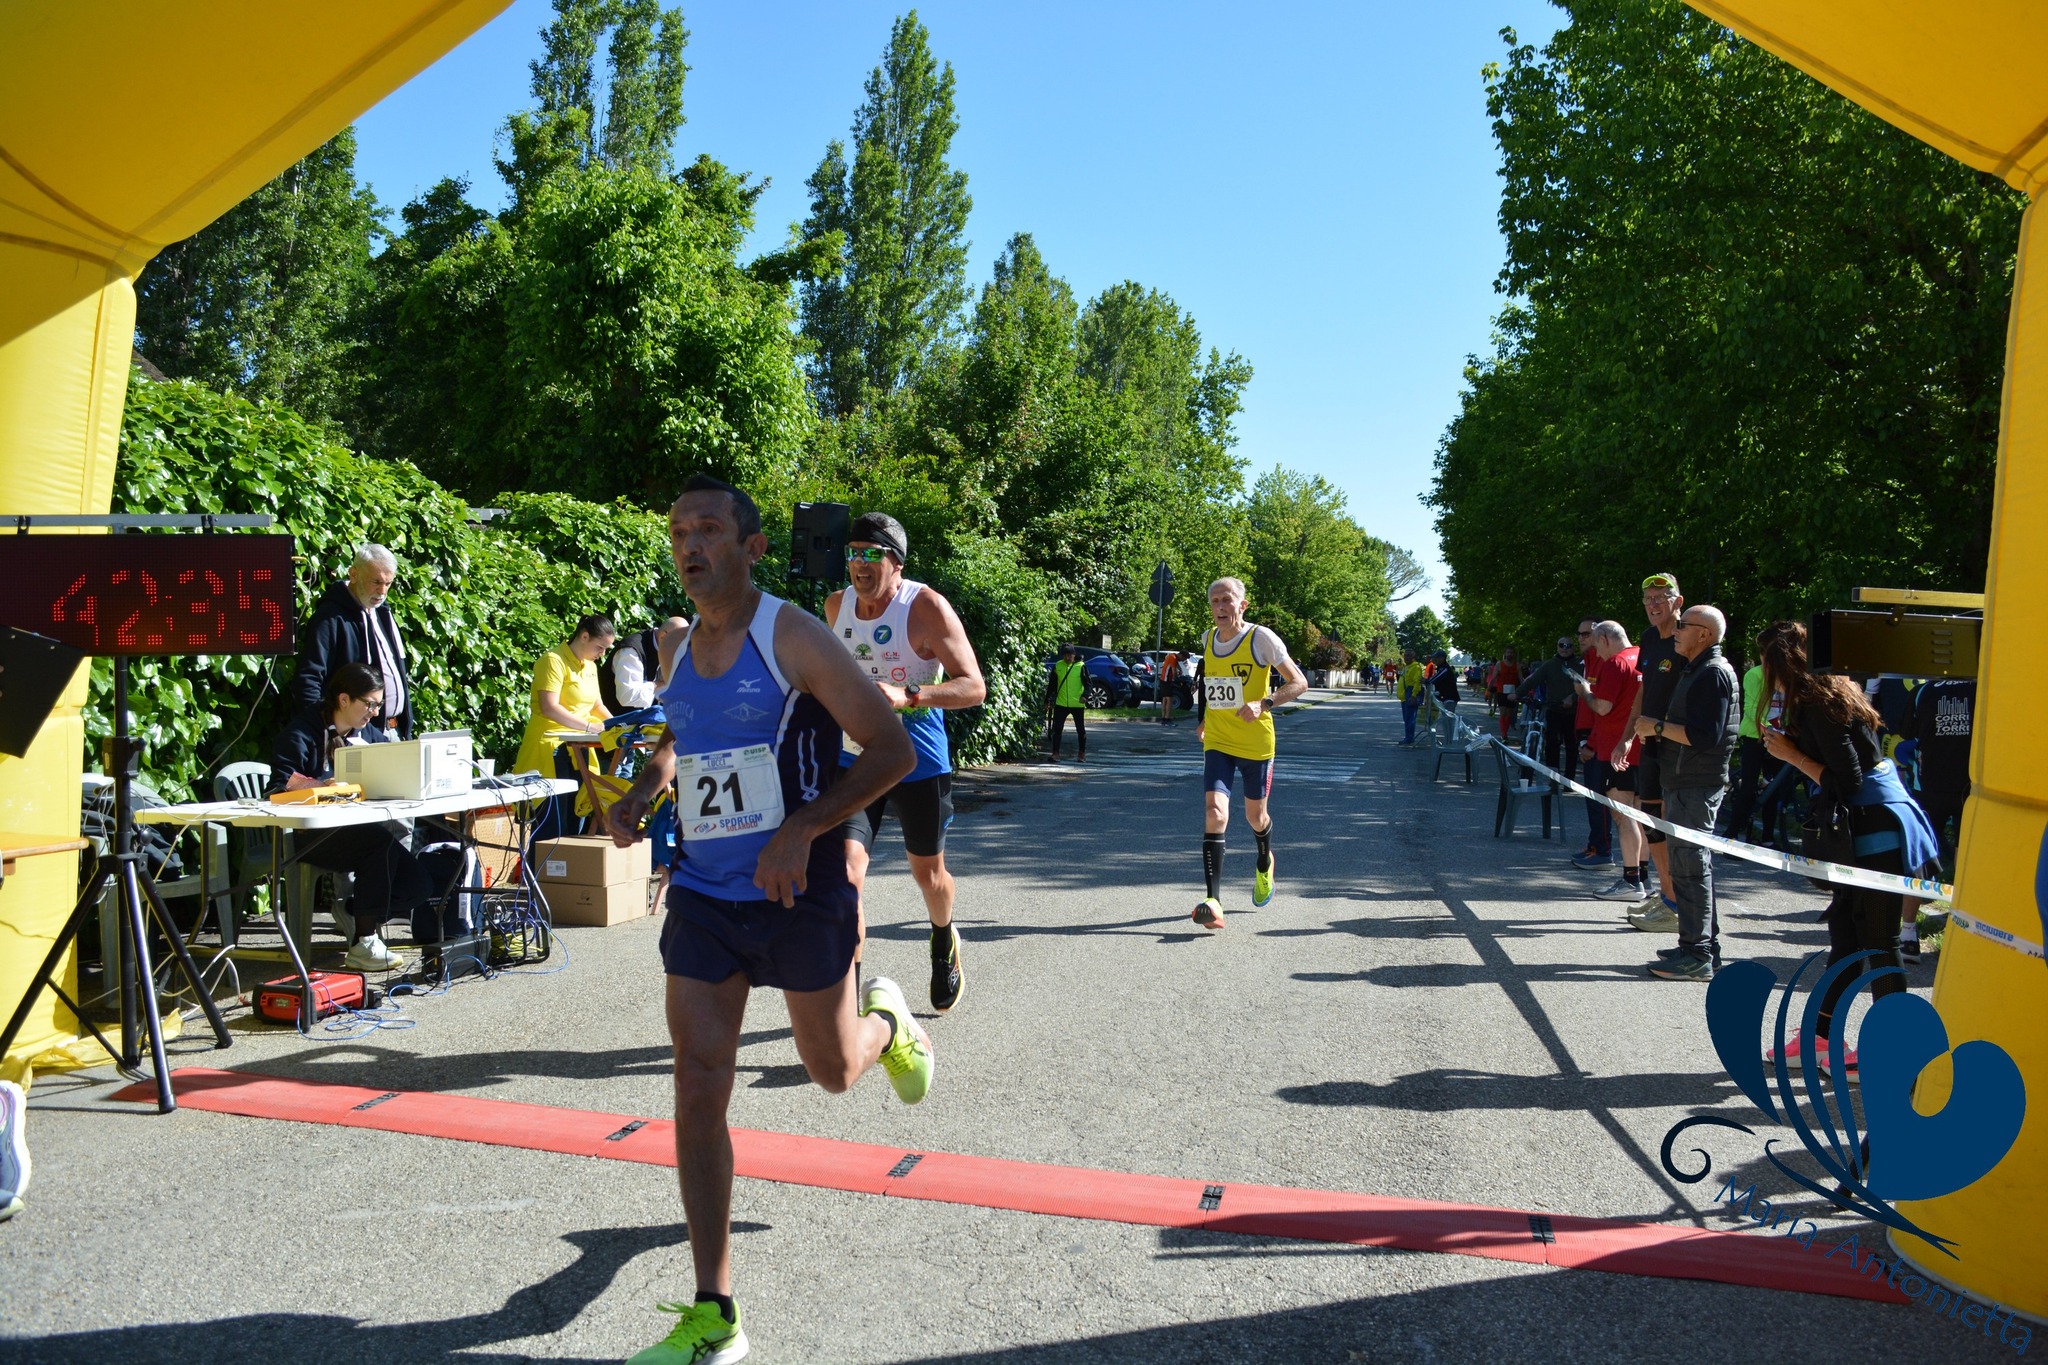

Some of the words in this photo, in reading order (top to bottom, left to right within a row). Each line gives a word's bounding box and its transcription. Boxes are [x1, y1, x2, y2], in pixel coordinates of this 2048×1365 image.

[53, 569, 285, 646] 42:35
[1208, 685, 1236, 701] 230
[1935, 713, 1970, 722] CORRI
[1936, 724, 1970, 733] TORRI
[697, 772, 744, 817] 21
[719, 812, 763, 828] SPORTGM
